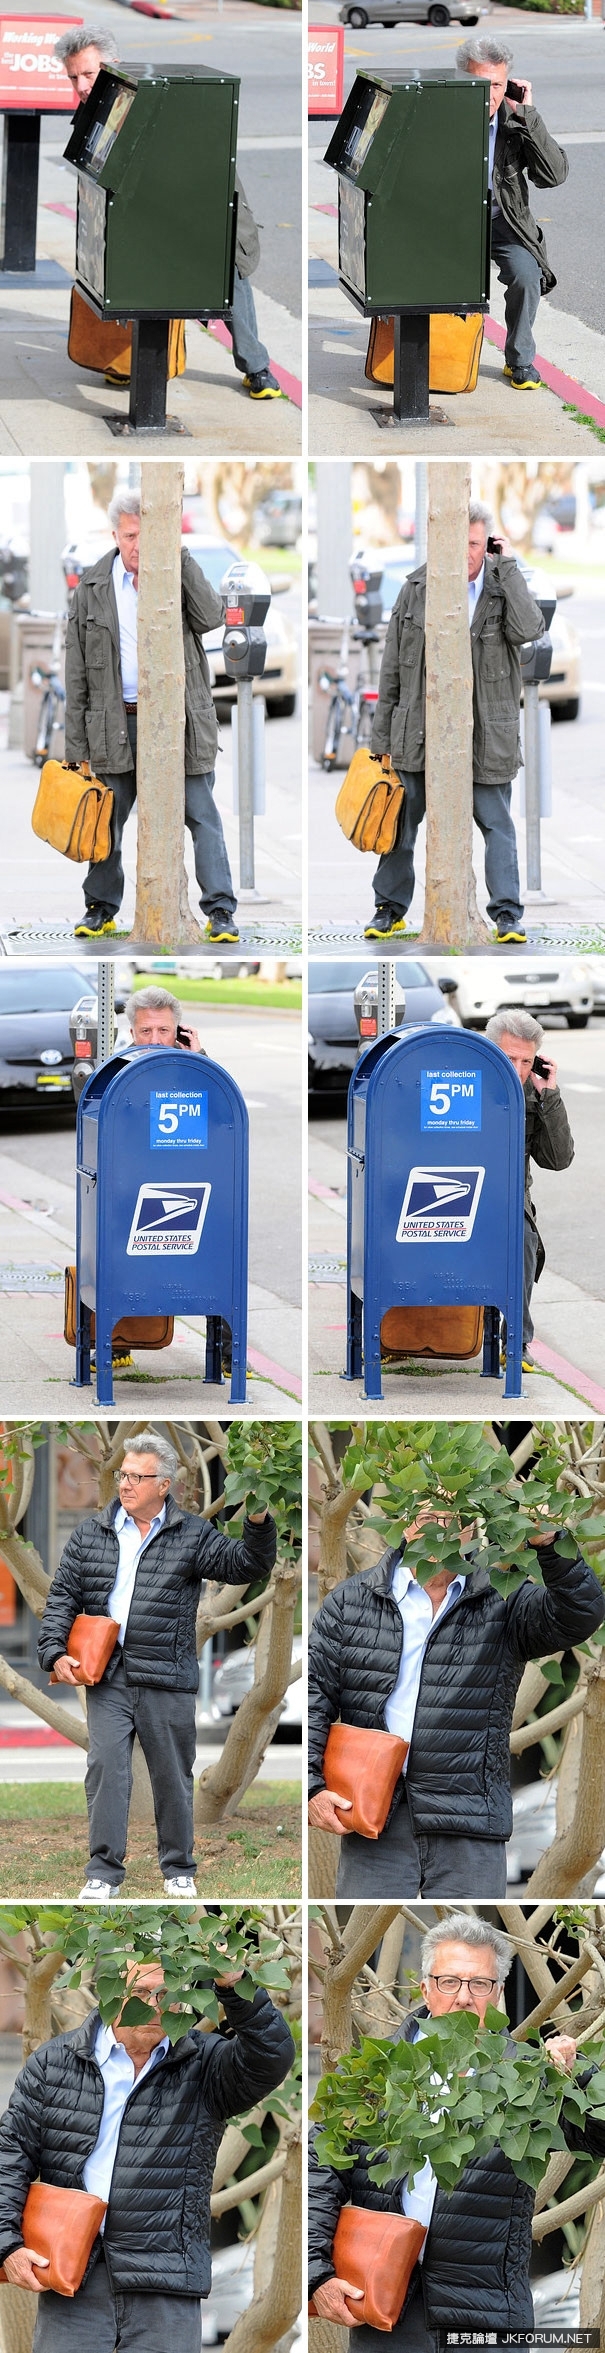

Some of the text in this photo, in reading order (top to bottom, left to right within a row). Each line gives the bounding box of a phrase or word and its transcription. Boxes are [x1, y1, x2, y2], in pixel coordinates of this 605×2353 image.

[2, 31, 44, 47] Working
[9, 53, 64, 74] JOBS
[427, 1071, 440, 1079] last
[155, 1091, 203, 1099] last collection
[460, 1119, 476, 1127] friday
[403, 1220, 465, 1229] UNITED STATES
[401, 1230, 467, 1238] POSTAL SERVICE
[133, 1234, 192, 1243] UNITED STATES
[131, 1243, 194, 1251] POSTAL SERVICE
